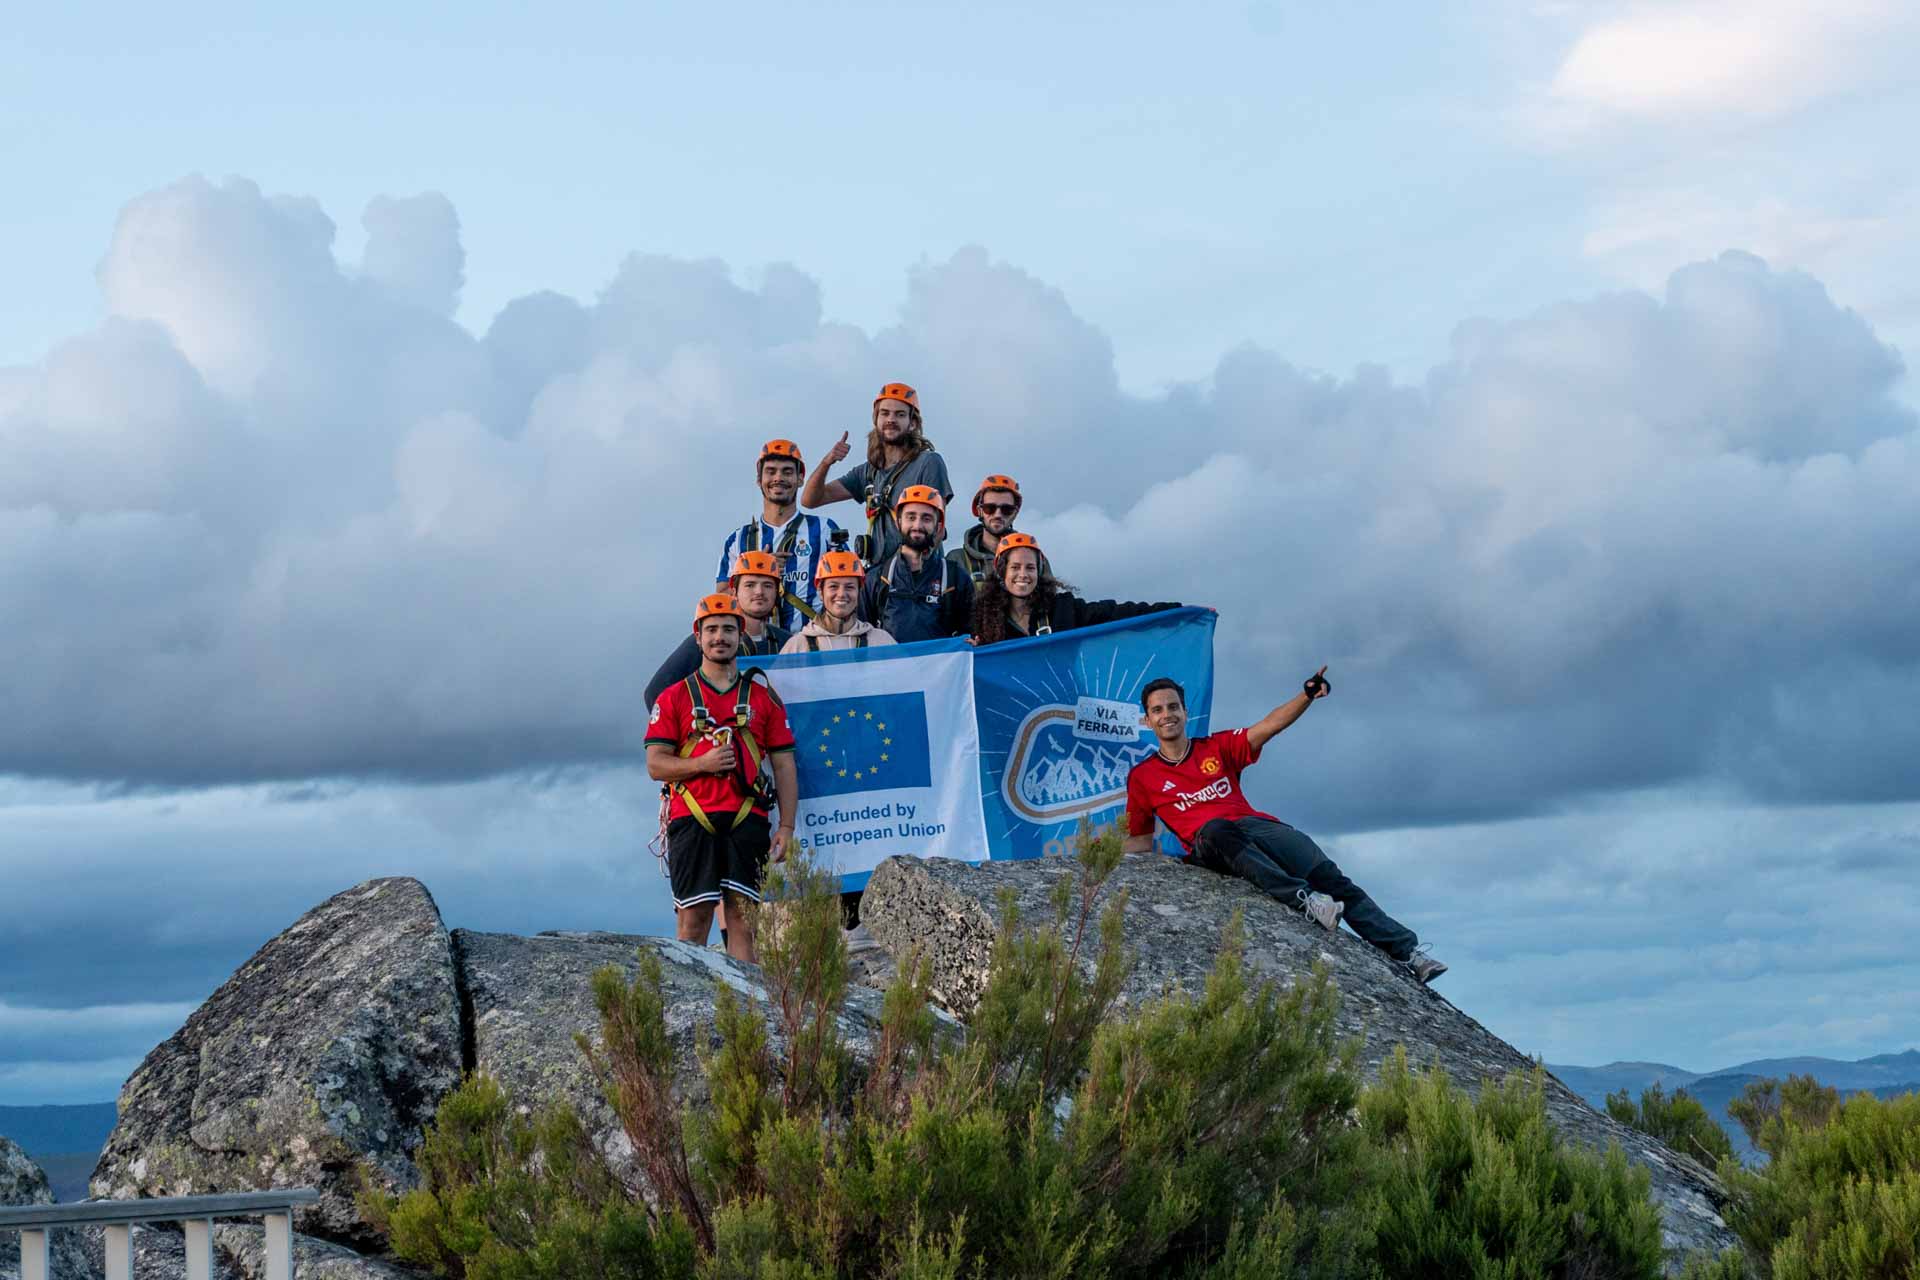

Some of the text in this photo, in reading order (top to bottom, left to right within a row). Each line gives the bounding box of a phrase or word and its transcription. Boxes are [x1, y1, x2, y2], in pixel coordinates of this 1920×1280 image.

[780, 571, 809, 582] TANO
[1096, 707, 1118, 720] VIA
[1077, 720, 1134, 736] FERRATA
[805, 803, 916, 827] Co-funded by
[814, 827, 893, 847] European
[898, 823, 945, 838] Union
